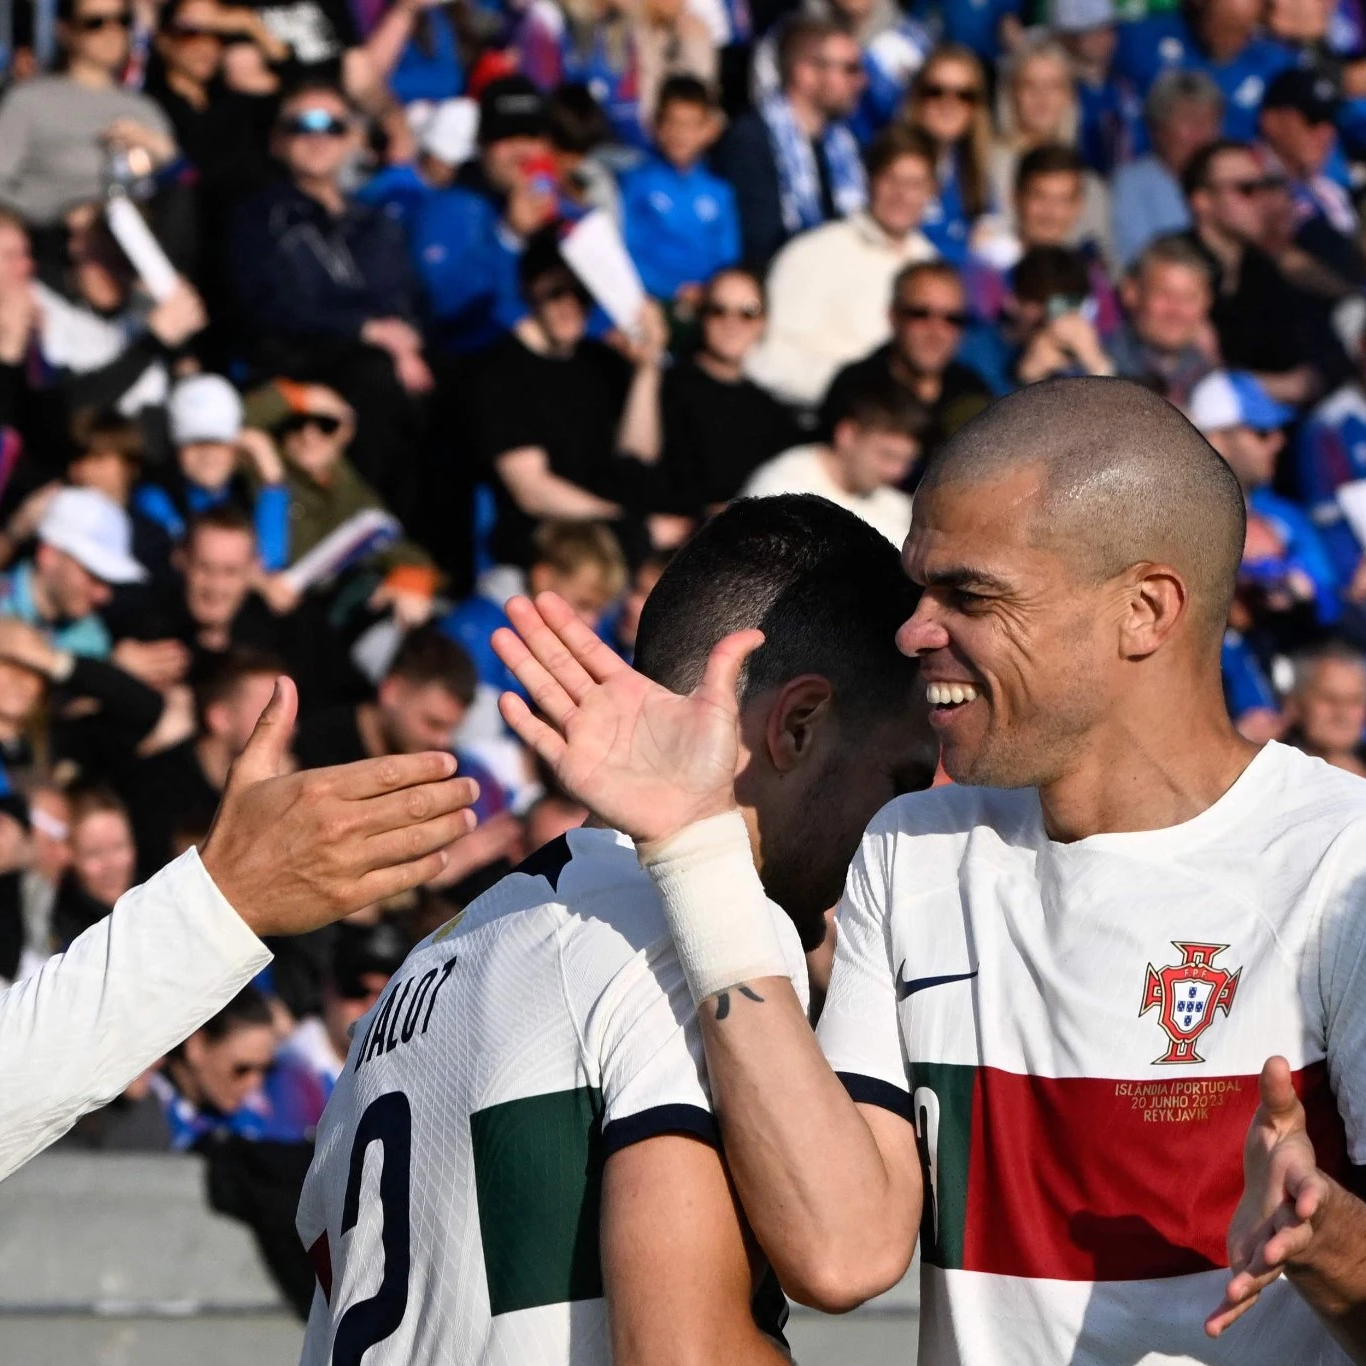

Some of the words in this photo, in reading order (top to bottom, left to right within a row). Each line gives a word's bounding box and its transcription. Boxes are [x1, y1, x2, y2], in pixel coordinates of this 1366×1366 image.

[1131, 1097, 1146, 1109] 20
[1149, 1096, 1188, 1108] JUNHO
[1192, 1095, 1223, 1107] 2023
